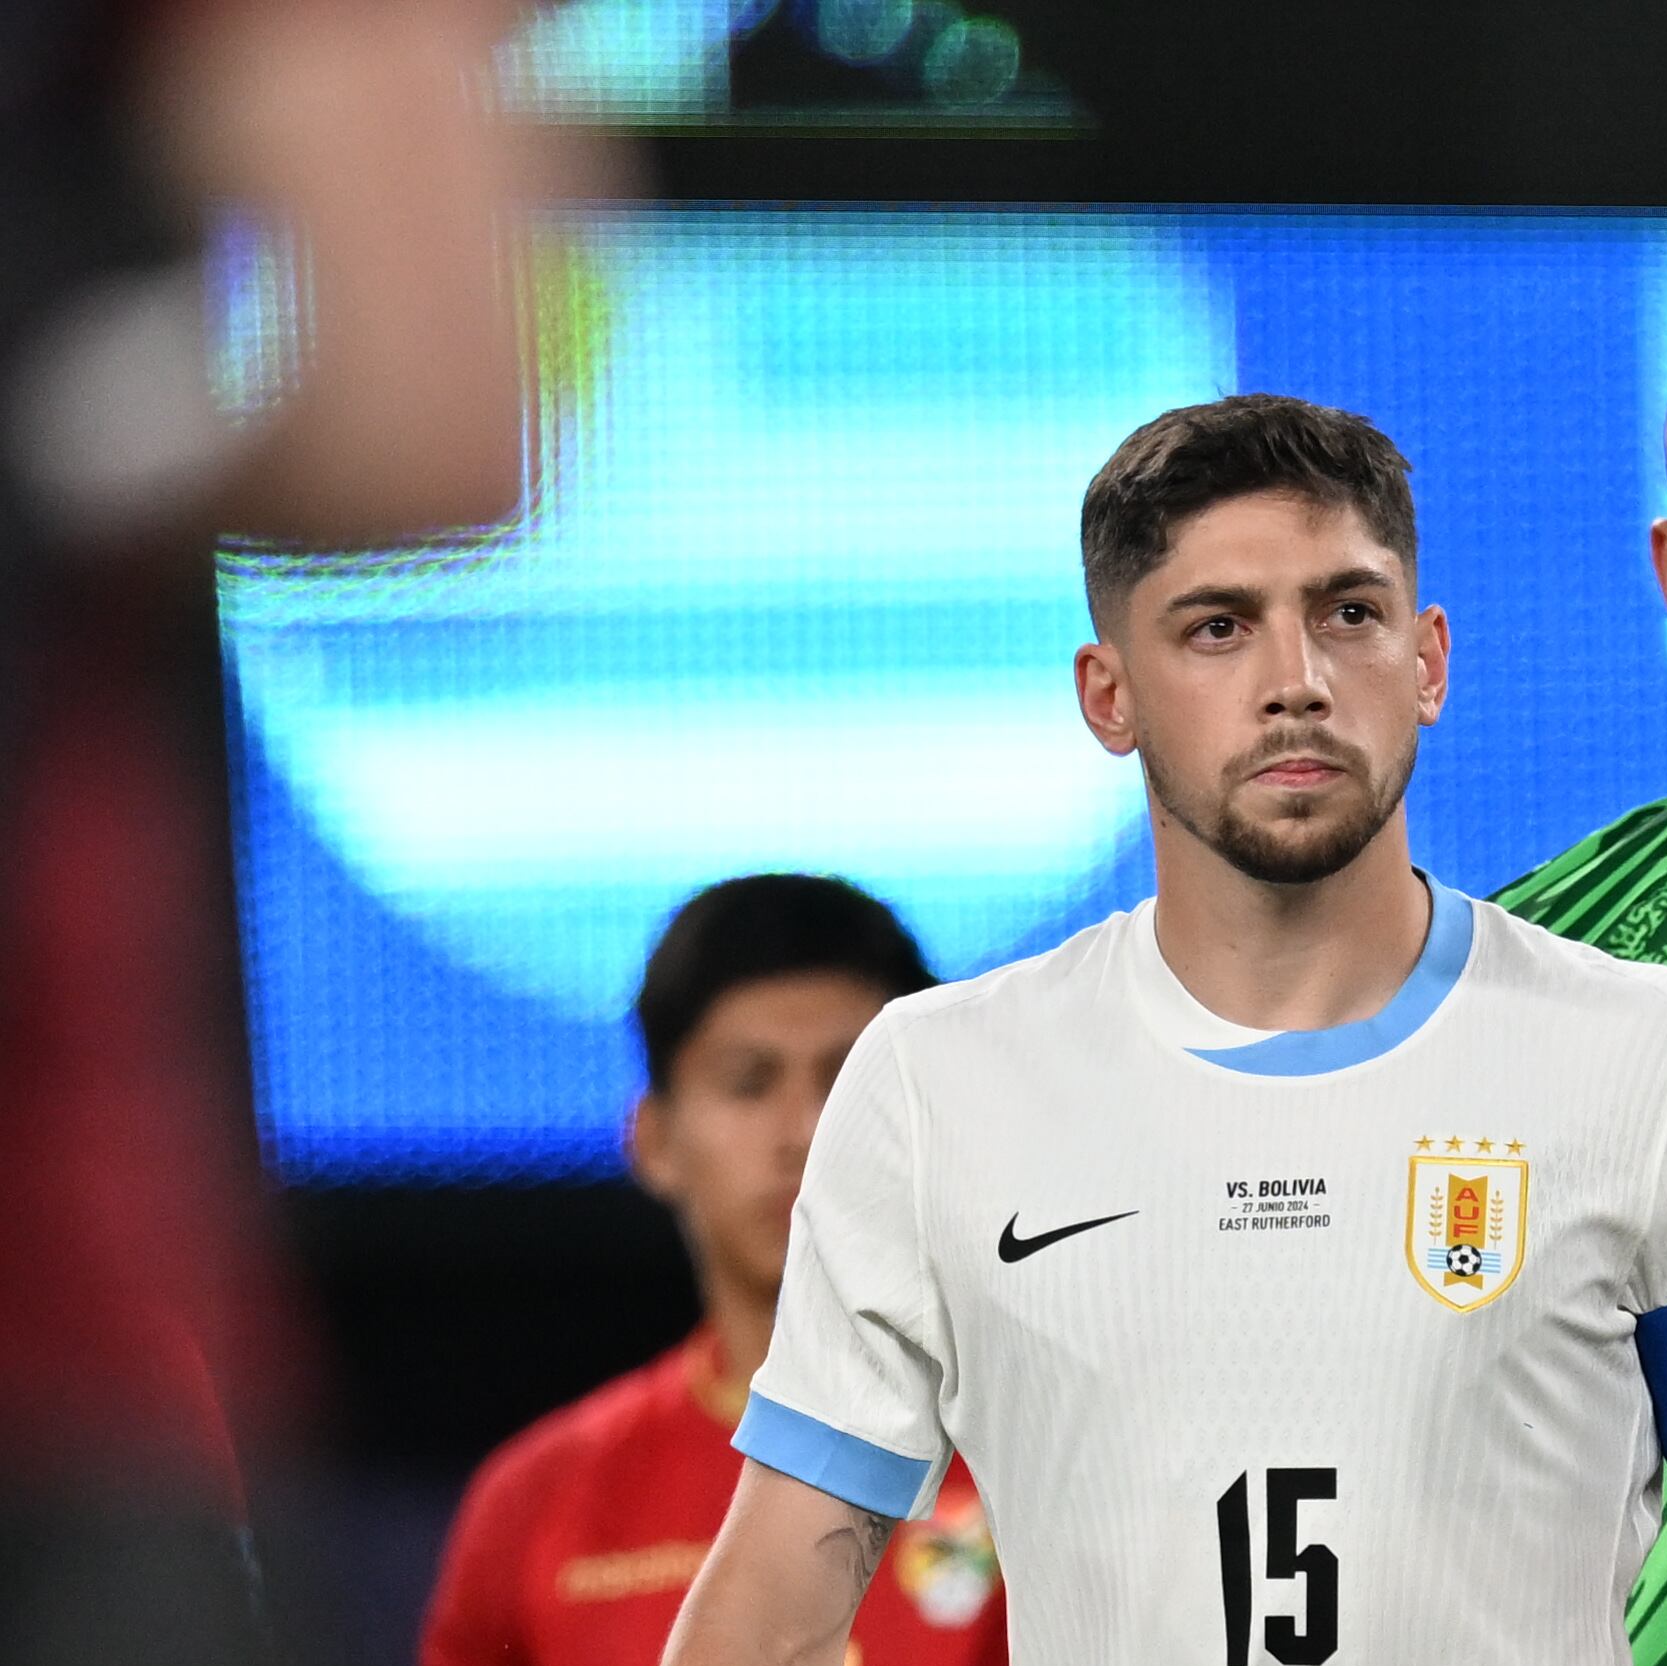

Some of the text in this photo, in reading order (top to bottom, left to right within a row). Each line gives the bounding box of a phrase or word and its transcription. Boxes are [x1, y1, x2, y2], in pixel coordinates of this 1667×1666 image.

[1226, 1178, 1327, 1198] VS. BOLIVIA
[1242, 1200, 1309, 1213] 27 JUNIO 2024
[1453, 1187, 1480, 1238] AUF
[1219, 1214, 1331, 1231] EAST RUTHERFORD
